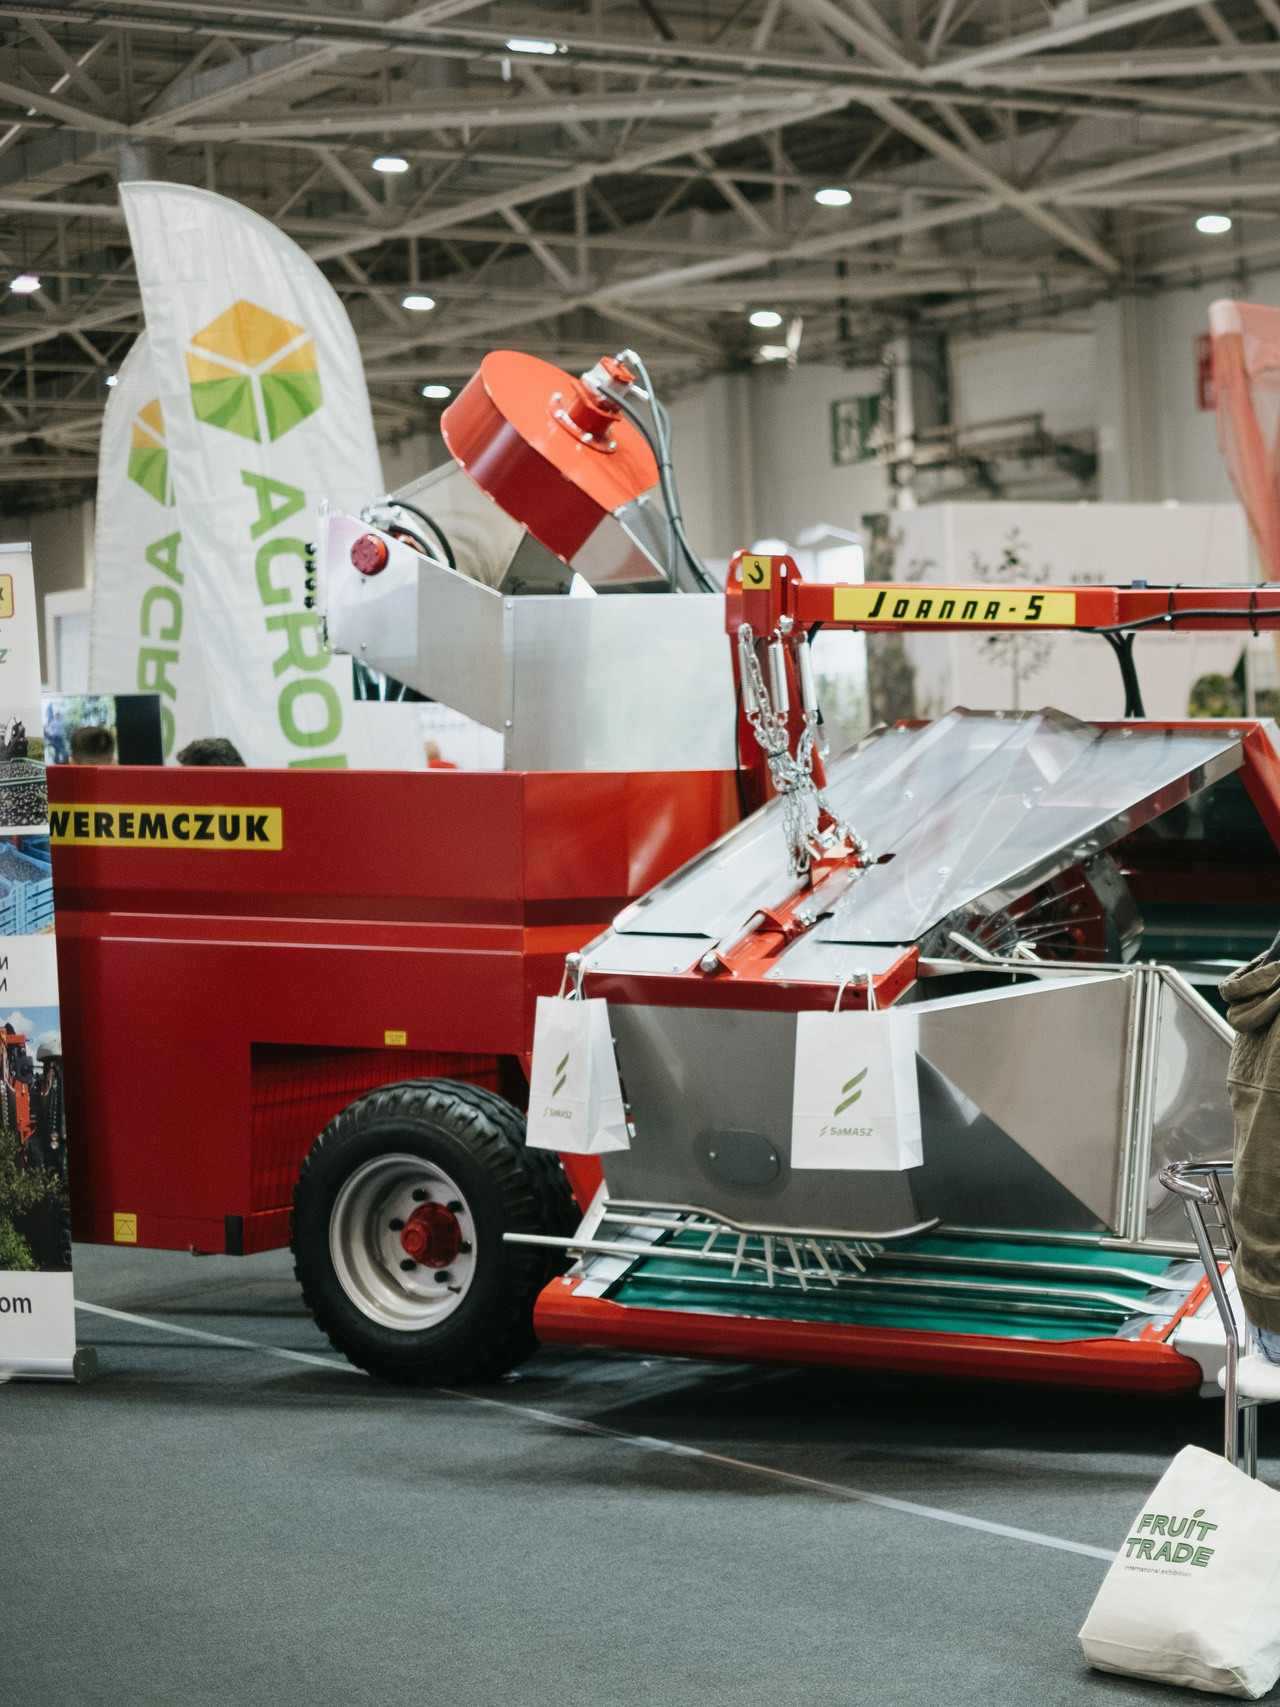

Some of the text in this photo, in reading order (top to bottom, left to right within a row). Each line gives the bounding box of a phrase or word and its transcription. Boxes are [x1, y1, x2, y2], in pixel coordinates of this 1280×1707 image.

[241, 470, 349, 768] AGRO
[50, 811, 270, 842] WEREMCZUK
[830, 1126, 874, 1137] SaMASZ
[1137, 1509, 1218, 1541] FRUIT
[1126, 1537, 1215, 1568] TRADE
[1124, 1564, 1192, 1578] international exhibition
